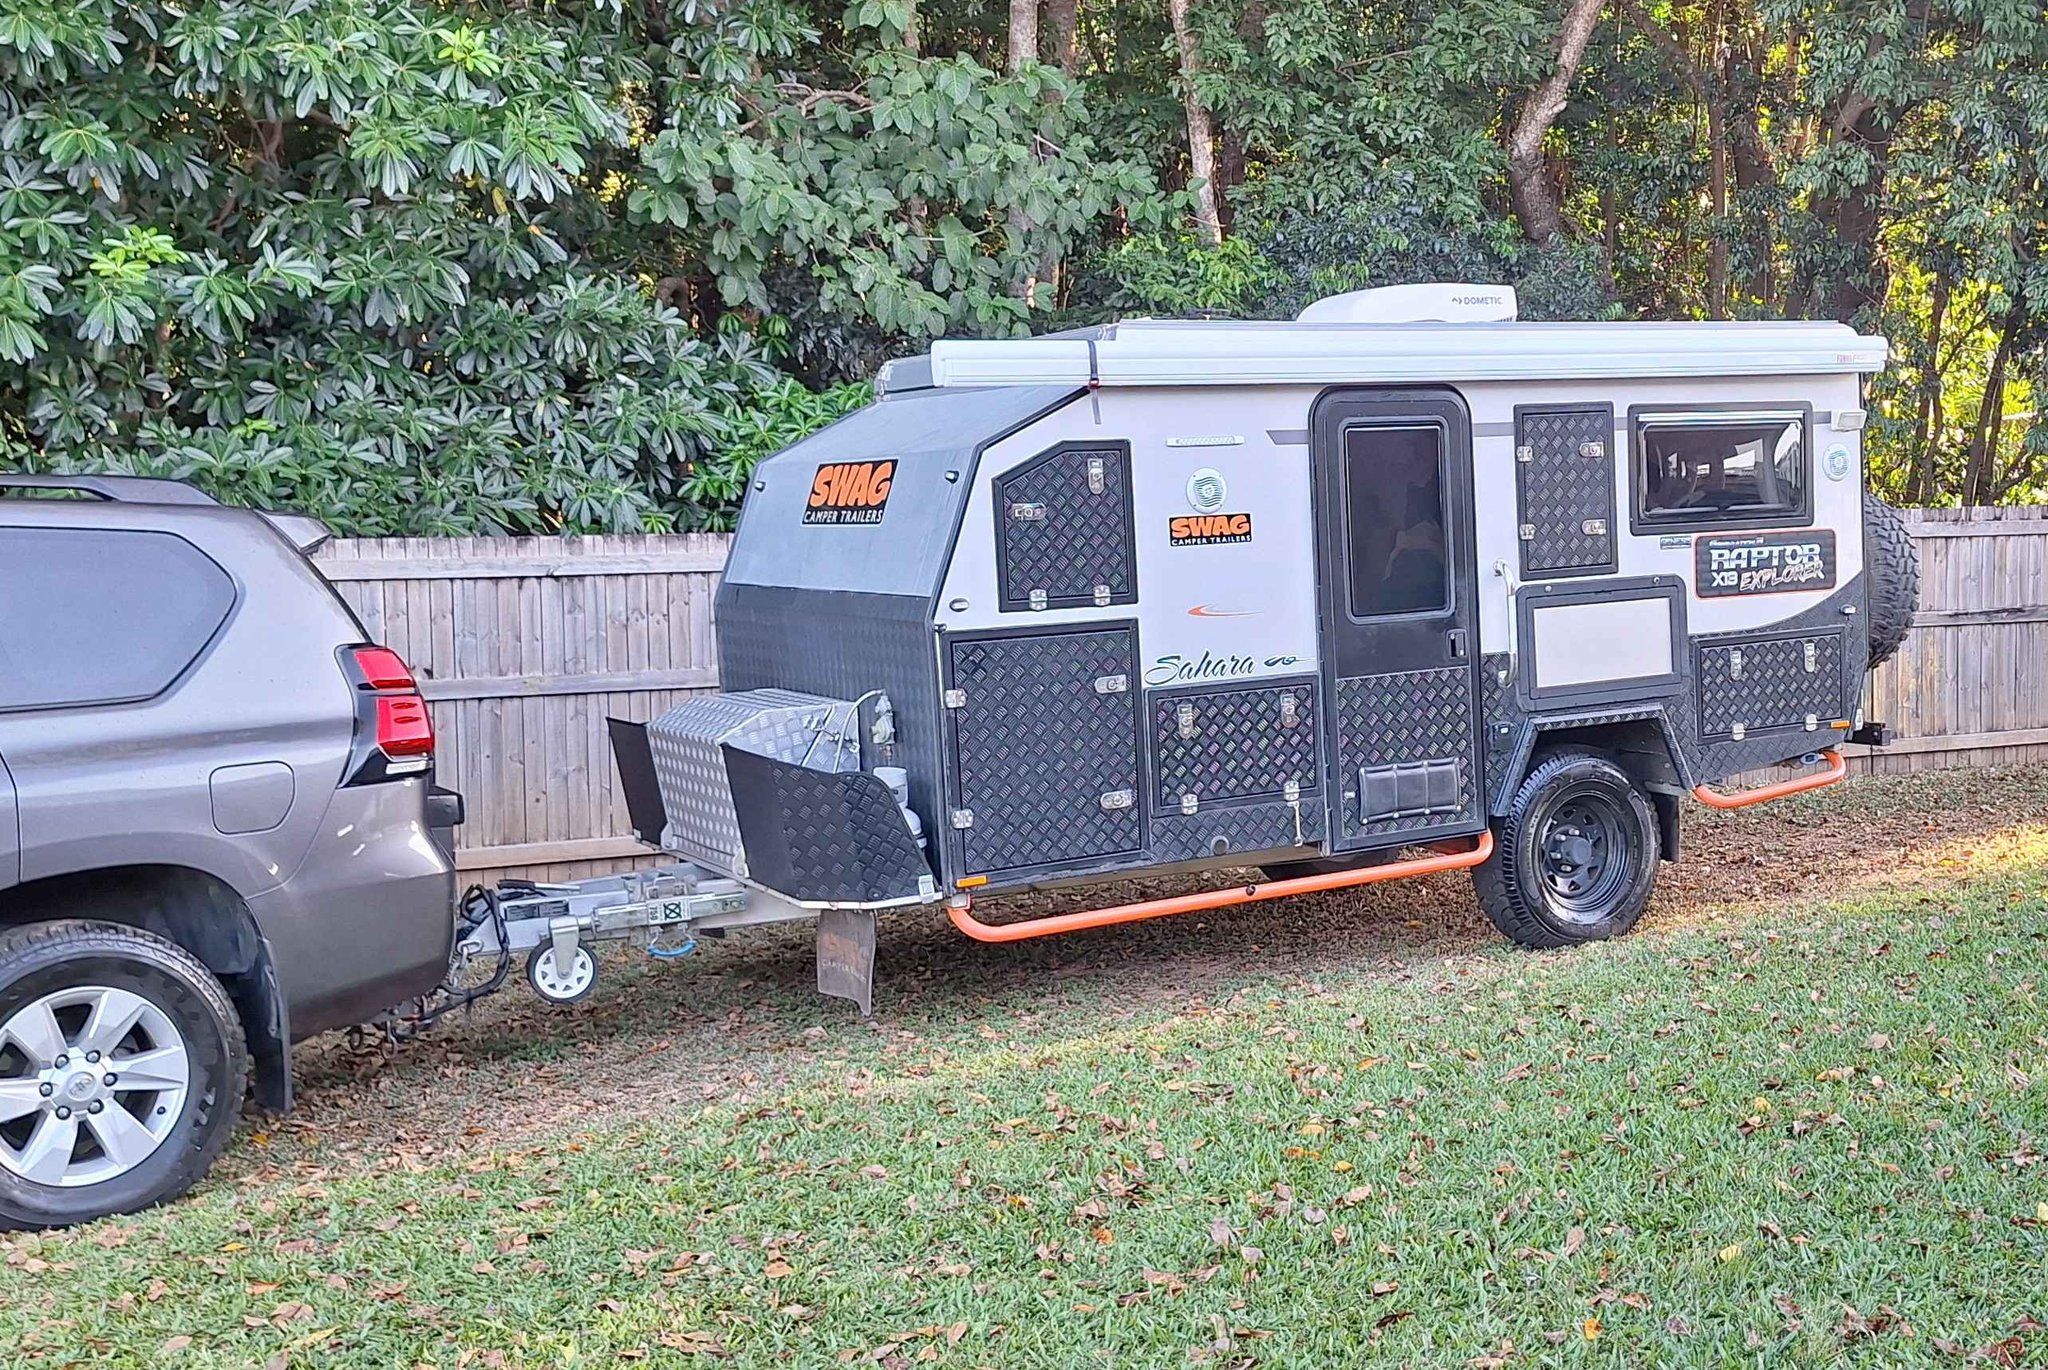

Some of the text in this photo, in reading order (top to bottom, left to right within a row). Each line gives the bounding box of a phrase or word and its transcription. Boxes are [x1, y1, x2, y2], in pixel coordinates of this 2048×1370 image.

[1463, 296, 1503, 305] DOMETIC
[809, 461, 892, 507] SWAG
[804, 509, 883, 523] CAMPER TRAILERS
[1171, 515, 1249, 538] SWAG
[1171, 535, 1251, 546] CAMPER TRAILERS
[1709, 543, 1821, 571] RAPTOR
[1711, 560, 1825, 591] X13 EXPLORER
[1144, 650, 1256, 685] Sahara
